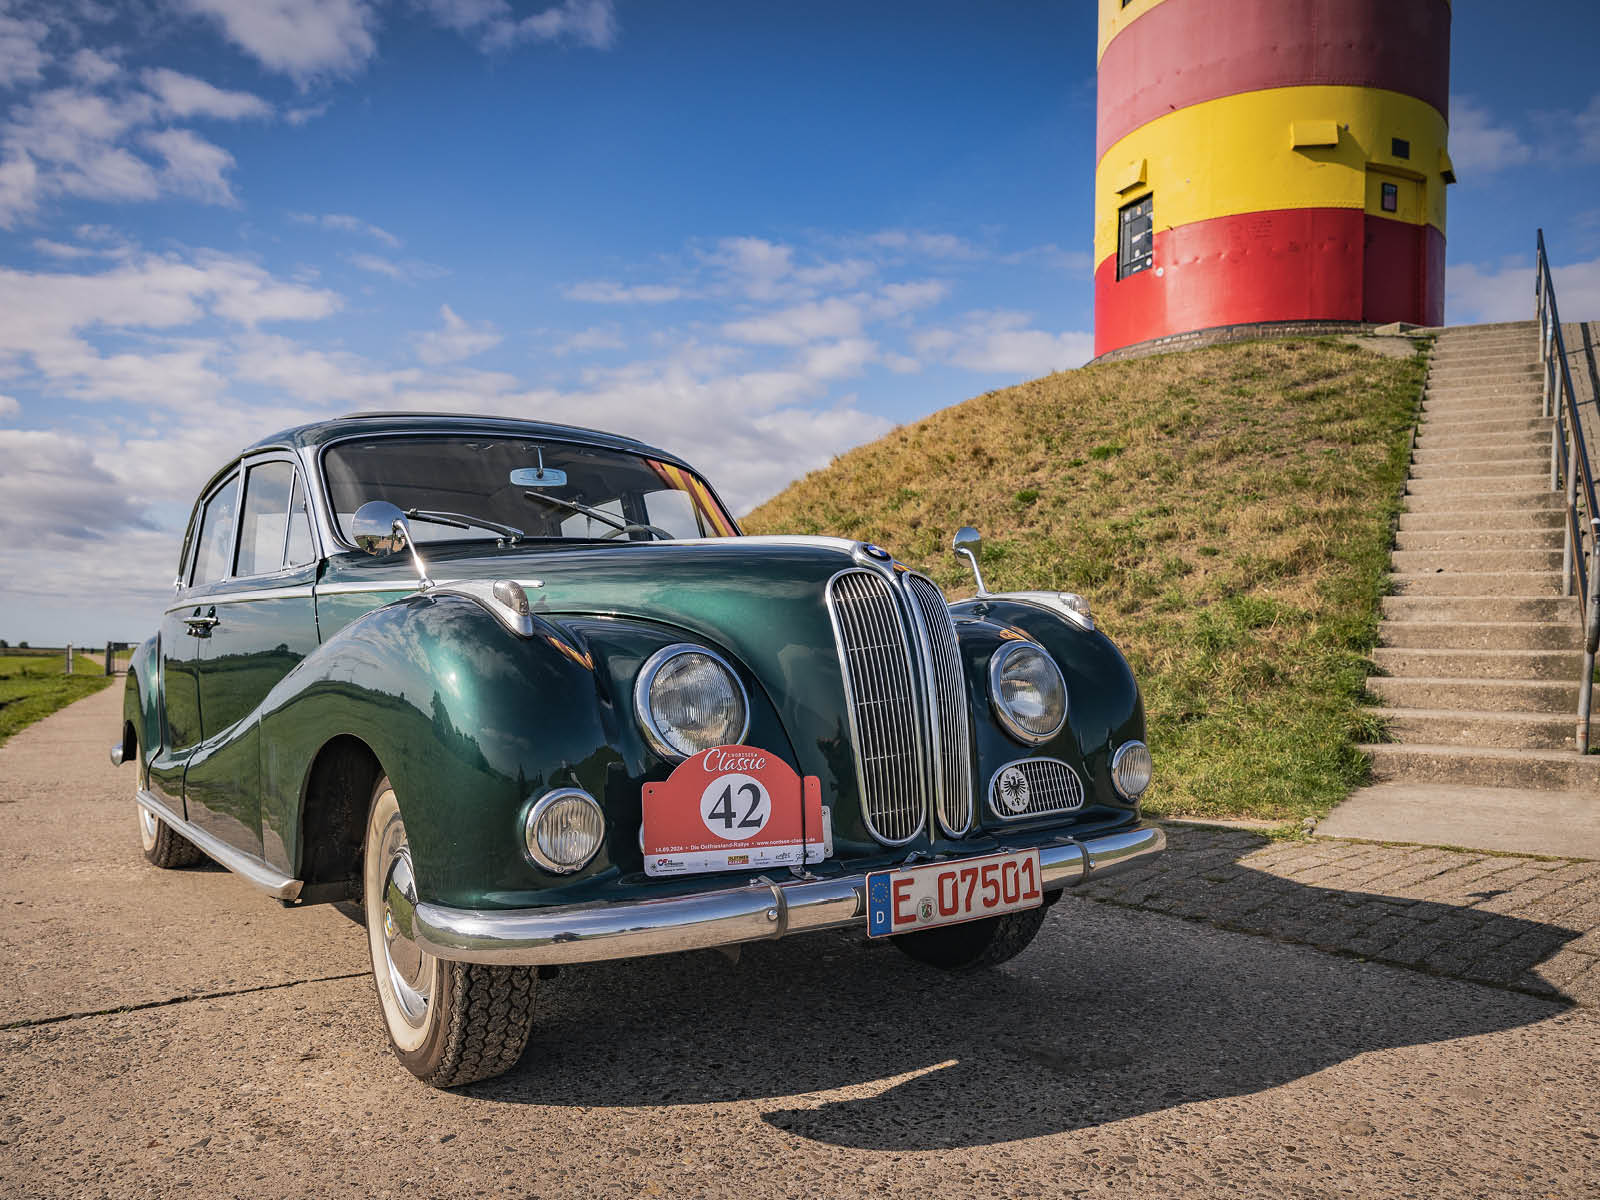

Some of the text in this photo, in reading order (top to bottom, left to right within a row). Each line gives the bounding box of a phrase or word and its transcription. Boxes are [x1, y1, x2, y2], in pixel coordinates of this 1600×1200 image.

[703, 749, 767, 772] Classic
[708, 783, 764, 829] 42
[700, 840, 749, 850] Ostfriesland-Rallye
[893, 857, 1040, 925] E 07501
[876, 911, 885, 924] D
